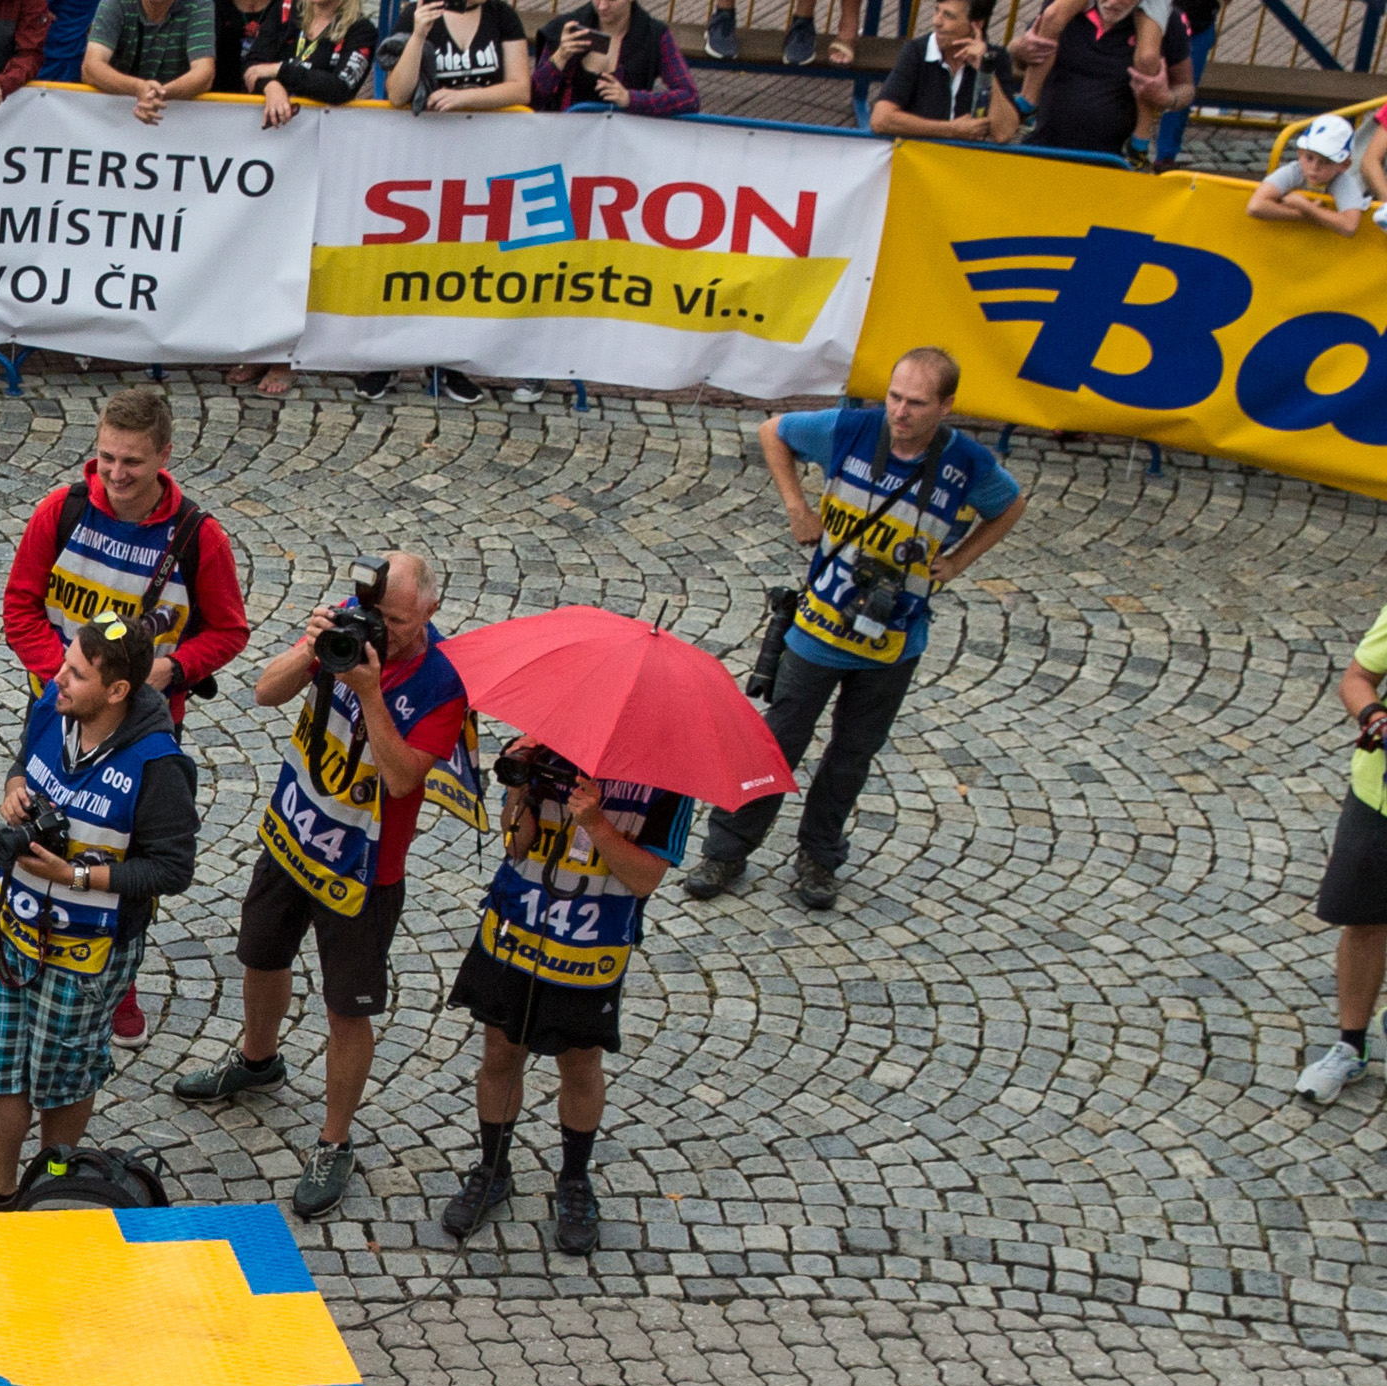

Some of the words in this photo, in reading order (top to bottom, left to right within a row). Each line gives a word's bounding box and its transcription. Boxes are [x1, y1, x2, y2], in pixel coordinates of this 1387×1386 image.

[362, 163, 817, 259] SHERON
[93, 260, 158, 312] ČR
[382, 260, 654, 309] motorista
[672, 278, 766, 324] ví...
[129, 546, 161, 567] RALLY
[47, 572, 98, 619] PHOTO
[102, 766, 132, 794] 009
[281, 781, 348, 863] 044
[262, 812, 327, 893] Barum
[520, 889, 601, 942] 142
